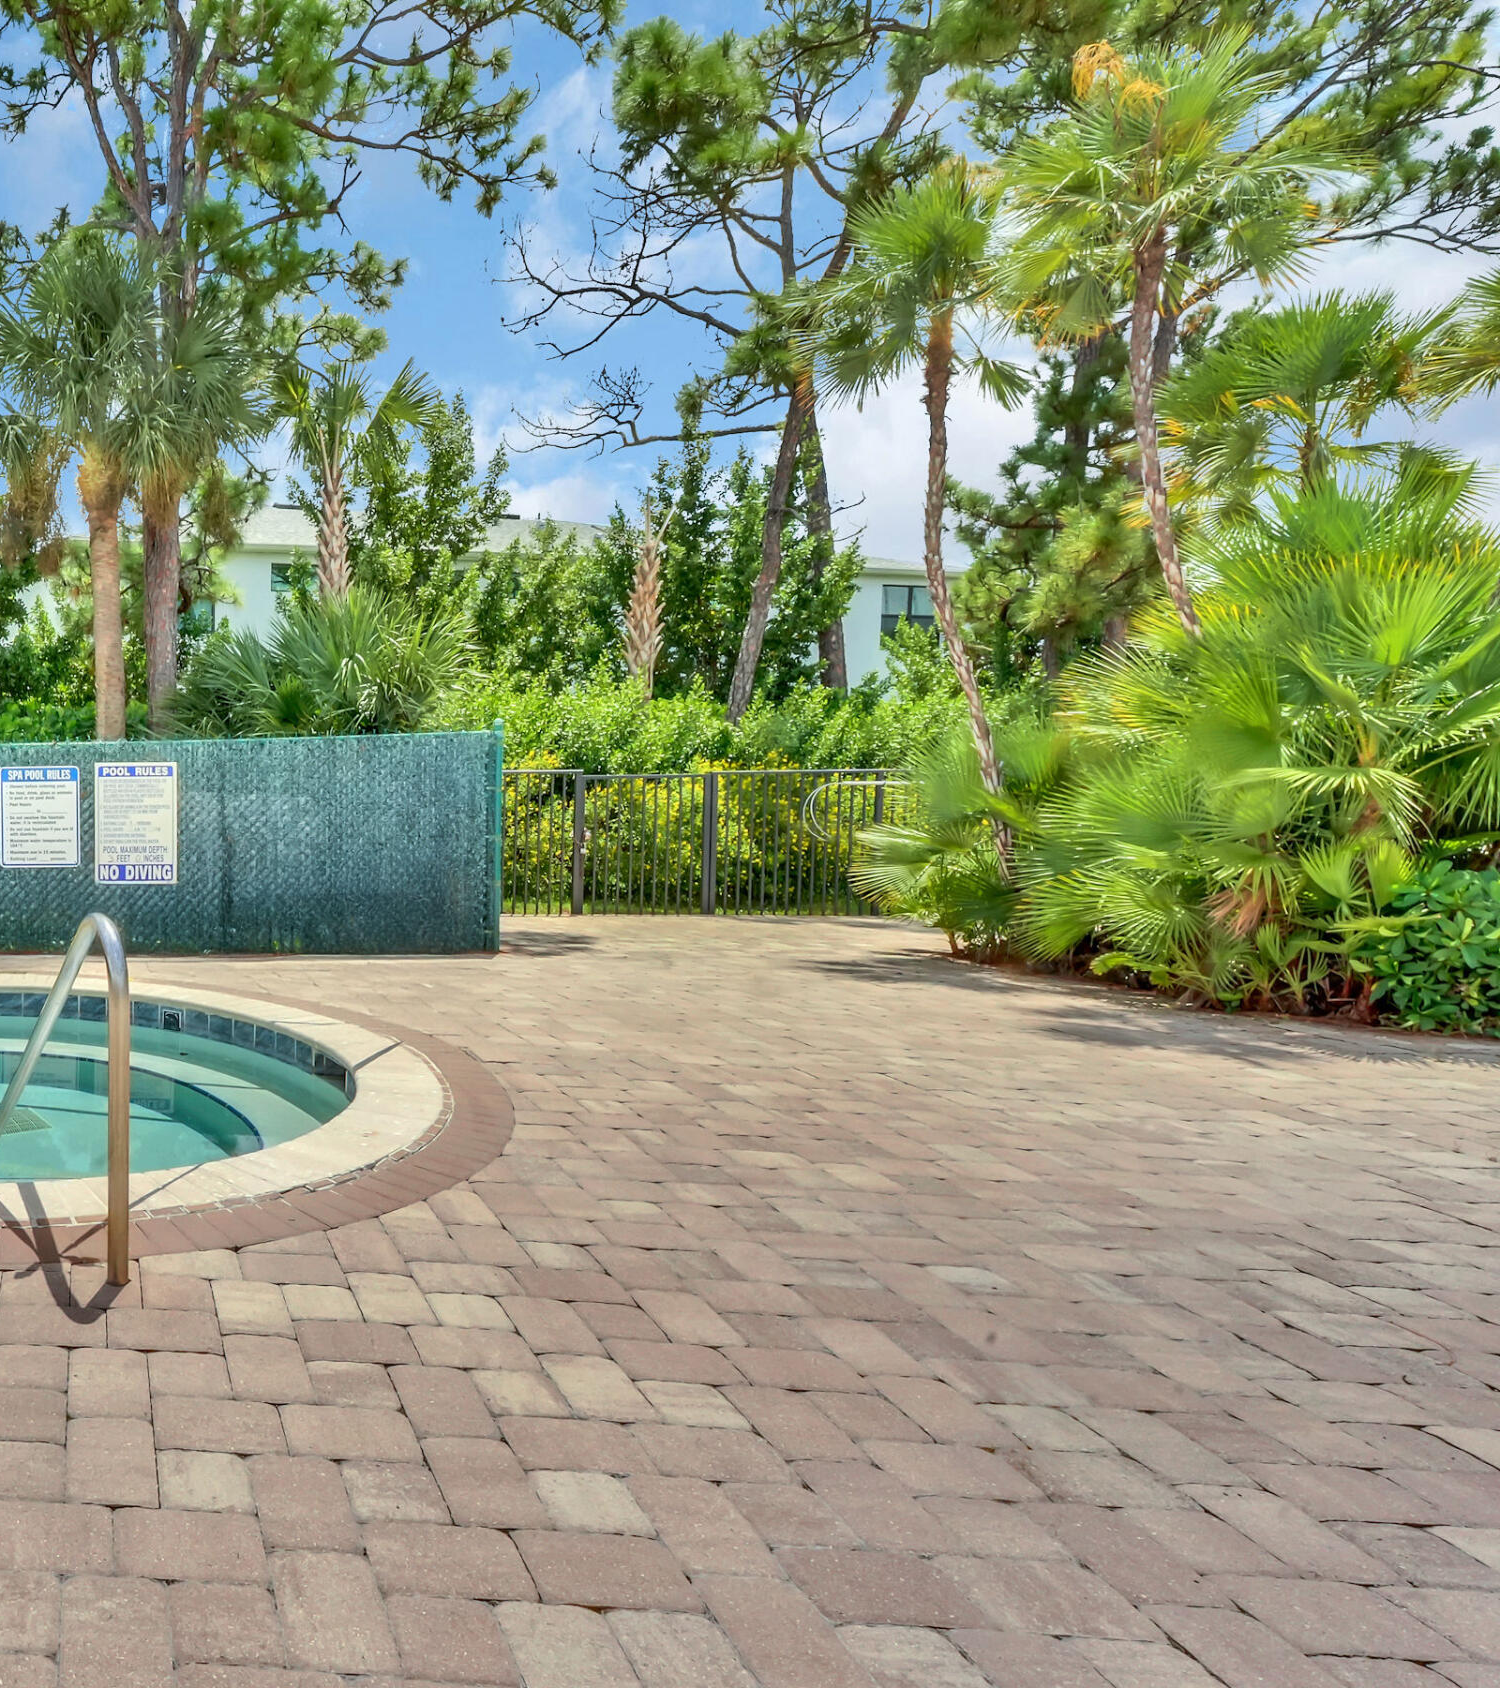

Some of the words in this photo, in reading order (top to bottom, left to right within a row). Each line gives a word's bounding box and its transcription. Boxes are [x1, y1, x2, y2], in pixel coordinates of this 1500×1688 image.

[7, 769, 24, 780] SPA
[25, 769, 44, 780] POOL
[46, 769, 71, 780] RULES
[103, 766, 130, 776] POOL
[135, 766, 168, 776] RULES
[103, 845, 118, 854] POOL
[119, 845, 147, 854] MAXIMUM
[116, 854, 130, 862] FEET
[143, 854, 164, 862] INCHES
[100, 865, 120, 880] NO
[125, 865, 172, 880] DIVING
